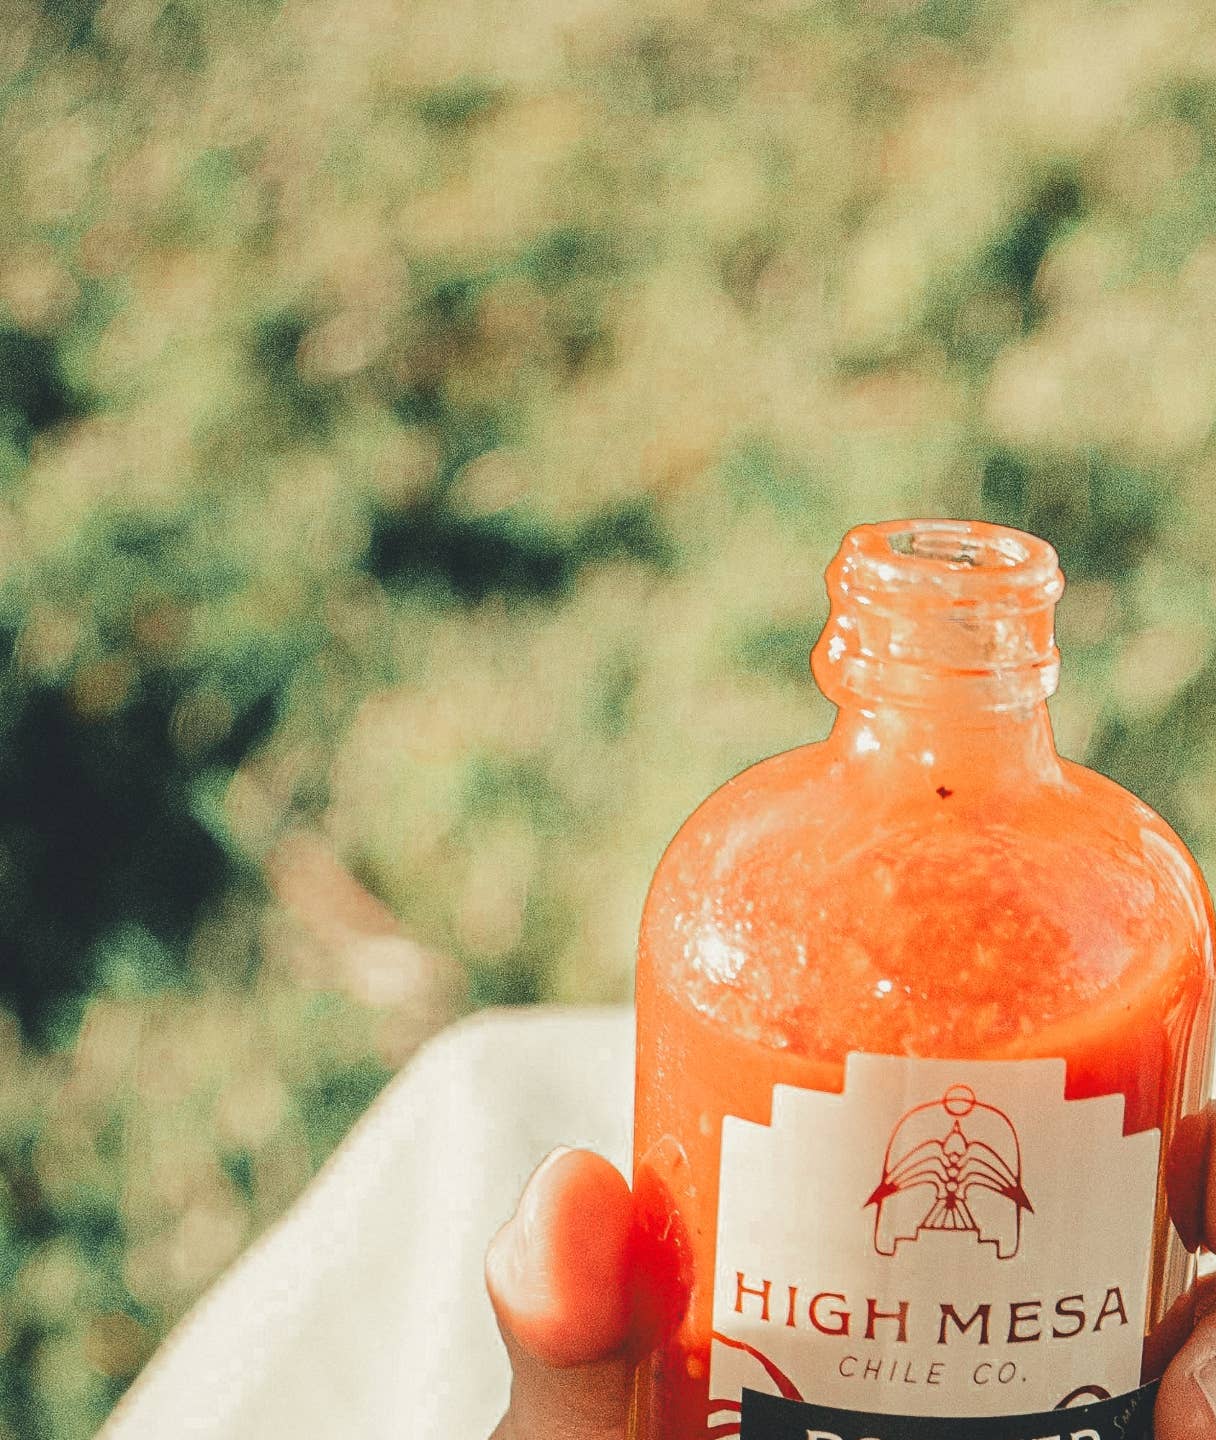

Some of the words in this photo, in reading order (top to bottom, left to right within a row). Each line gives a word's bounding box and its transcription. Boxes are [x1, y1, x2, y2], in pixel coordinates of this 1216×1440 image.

[734, 1271, 910, 1342] HIGH
[937, 1286, 1129, 1345] MESA
[838, 1355, 945, 1385] CHILE
[973, 1361, 1027, 1385] CO.
